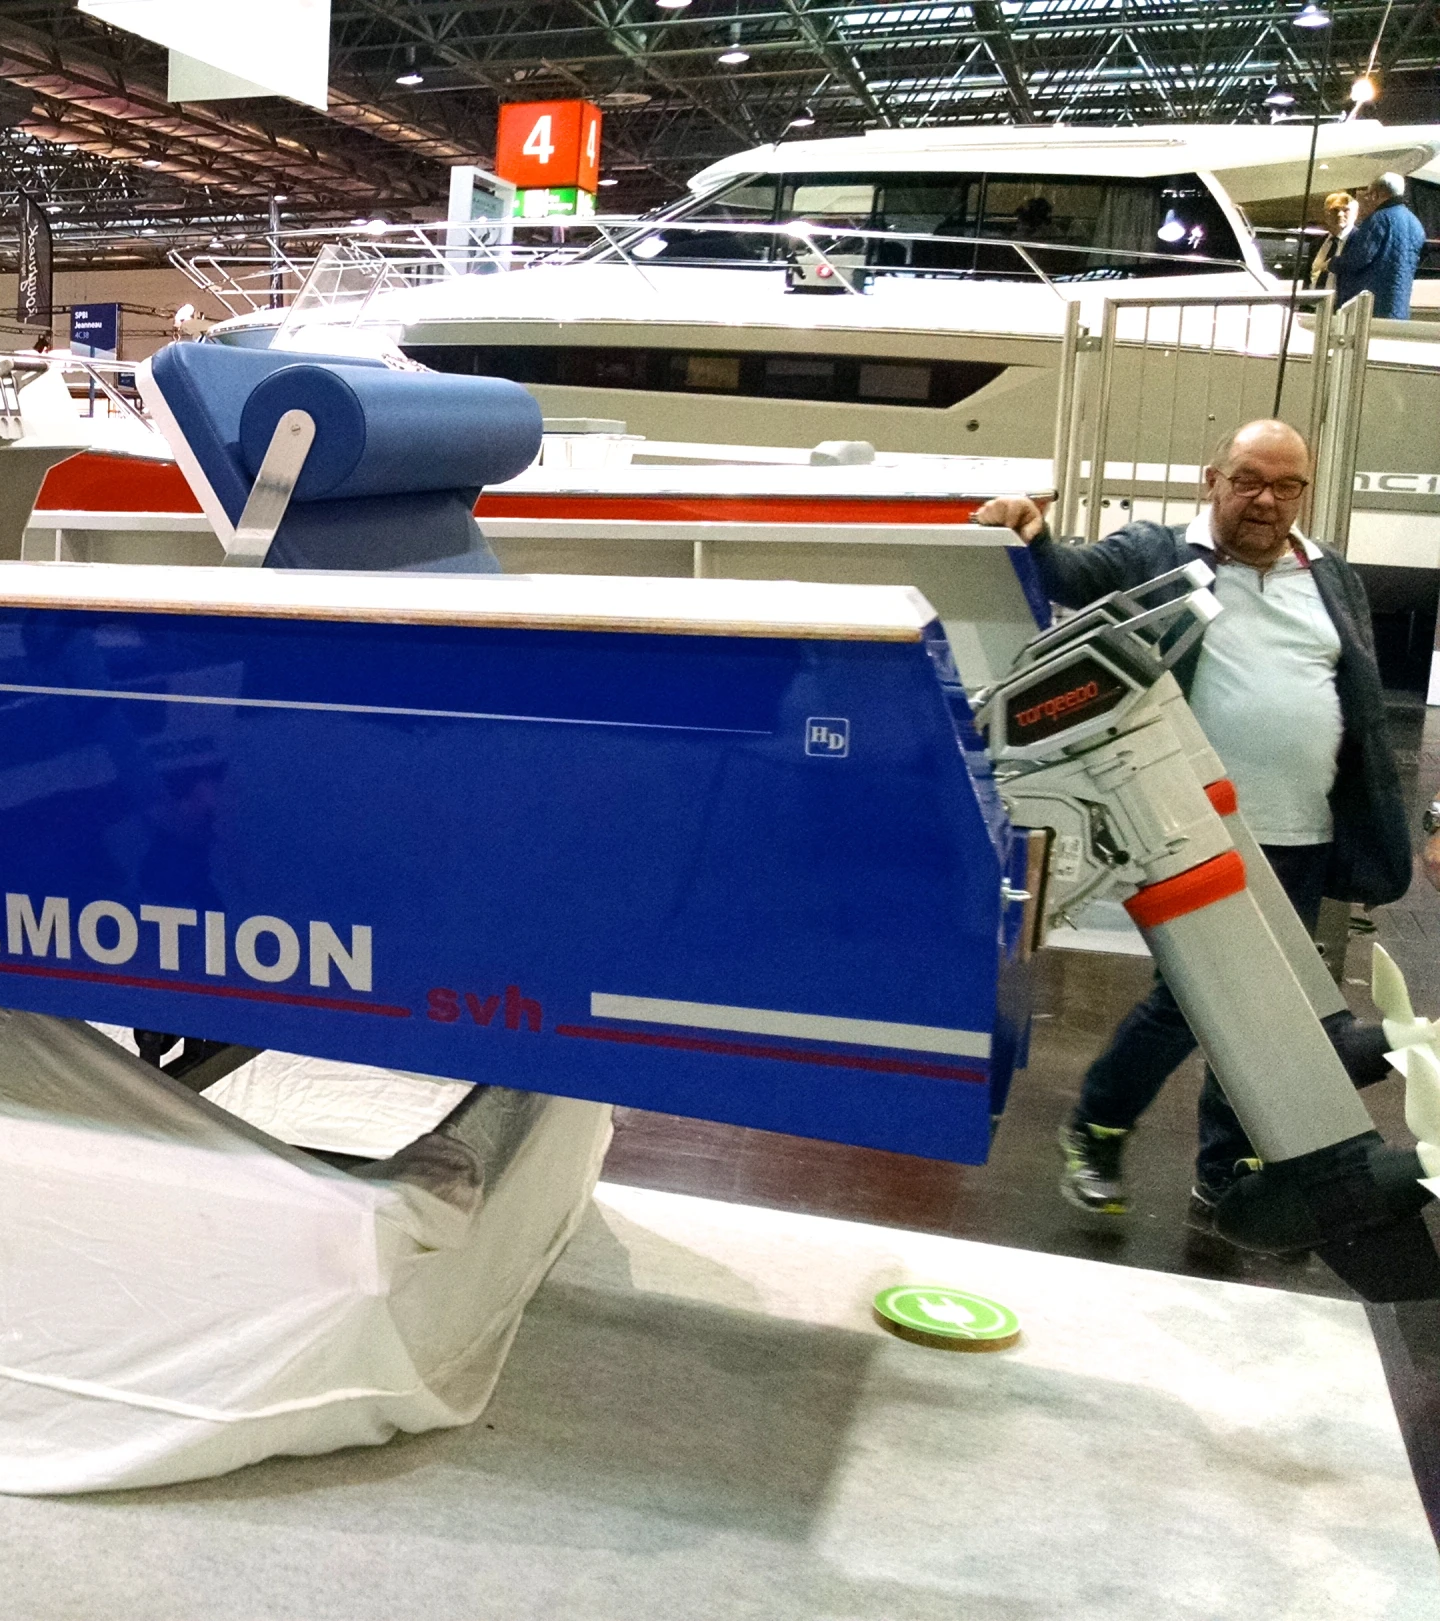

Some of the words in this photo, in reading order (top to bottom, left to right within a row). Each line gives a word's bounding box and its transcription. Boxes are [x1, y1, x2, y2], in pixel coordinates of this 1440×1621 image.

[522, 115, 555, 164] 4
[586, 120, 597, 168] 4
[1015, 681, 1099, 727] torqeedo
[426, 984, 543, 1033] svh
